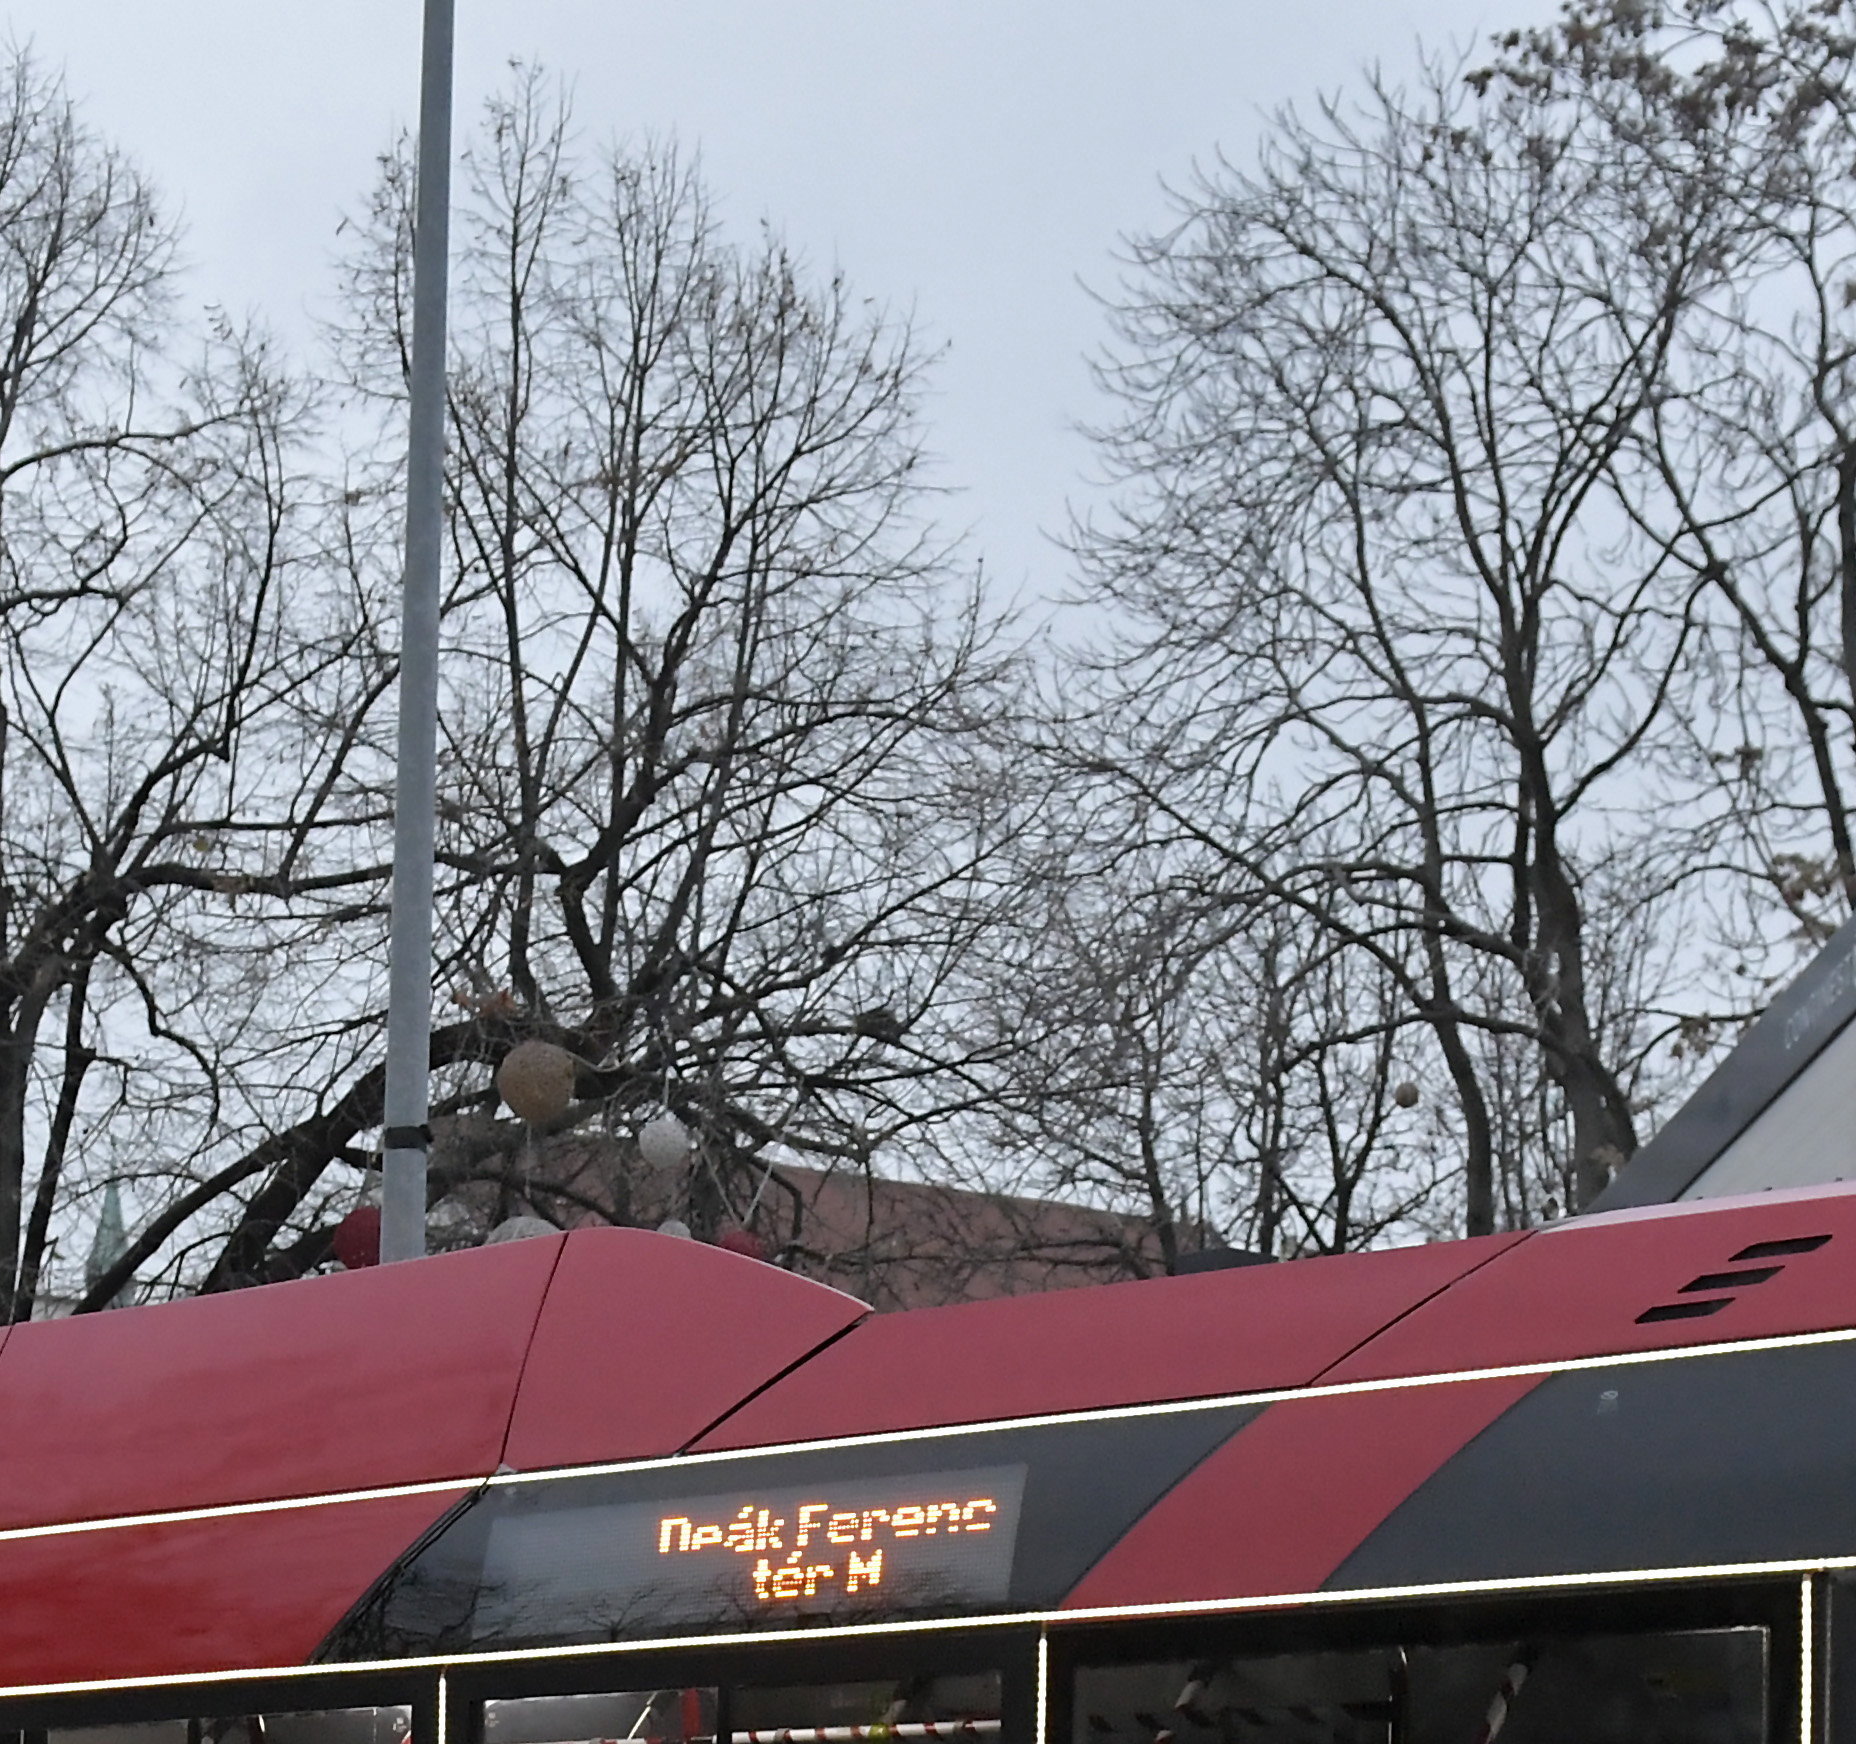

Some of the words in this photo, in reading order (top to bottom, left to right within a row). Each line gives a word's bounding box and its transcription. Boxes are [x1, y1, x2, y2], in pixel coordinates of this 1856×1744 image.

[796, 1499, 997, 1547] Ferenc
[752, 1550, 834, 1600] tér
[846, 1548, 883, 1593] M
